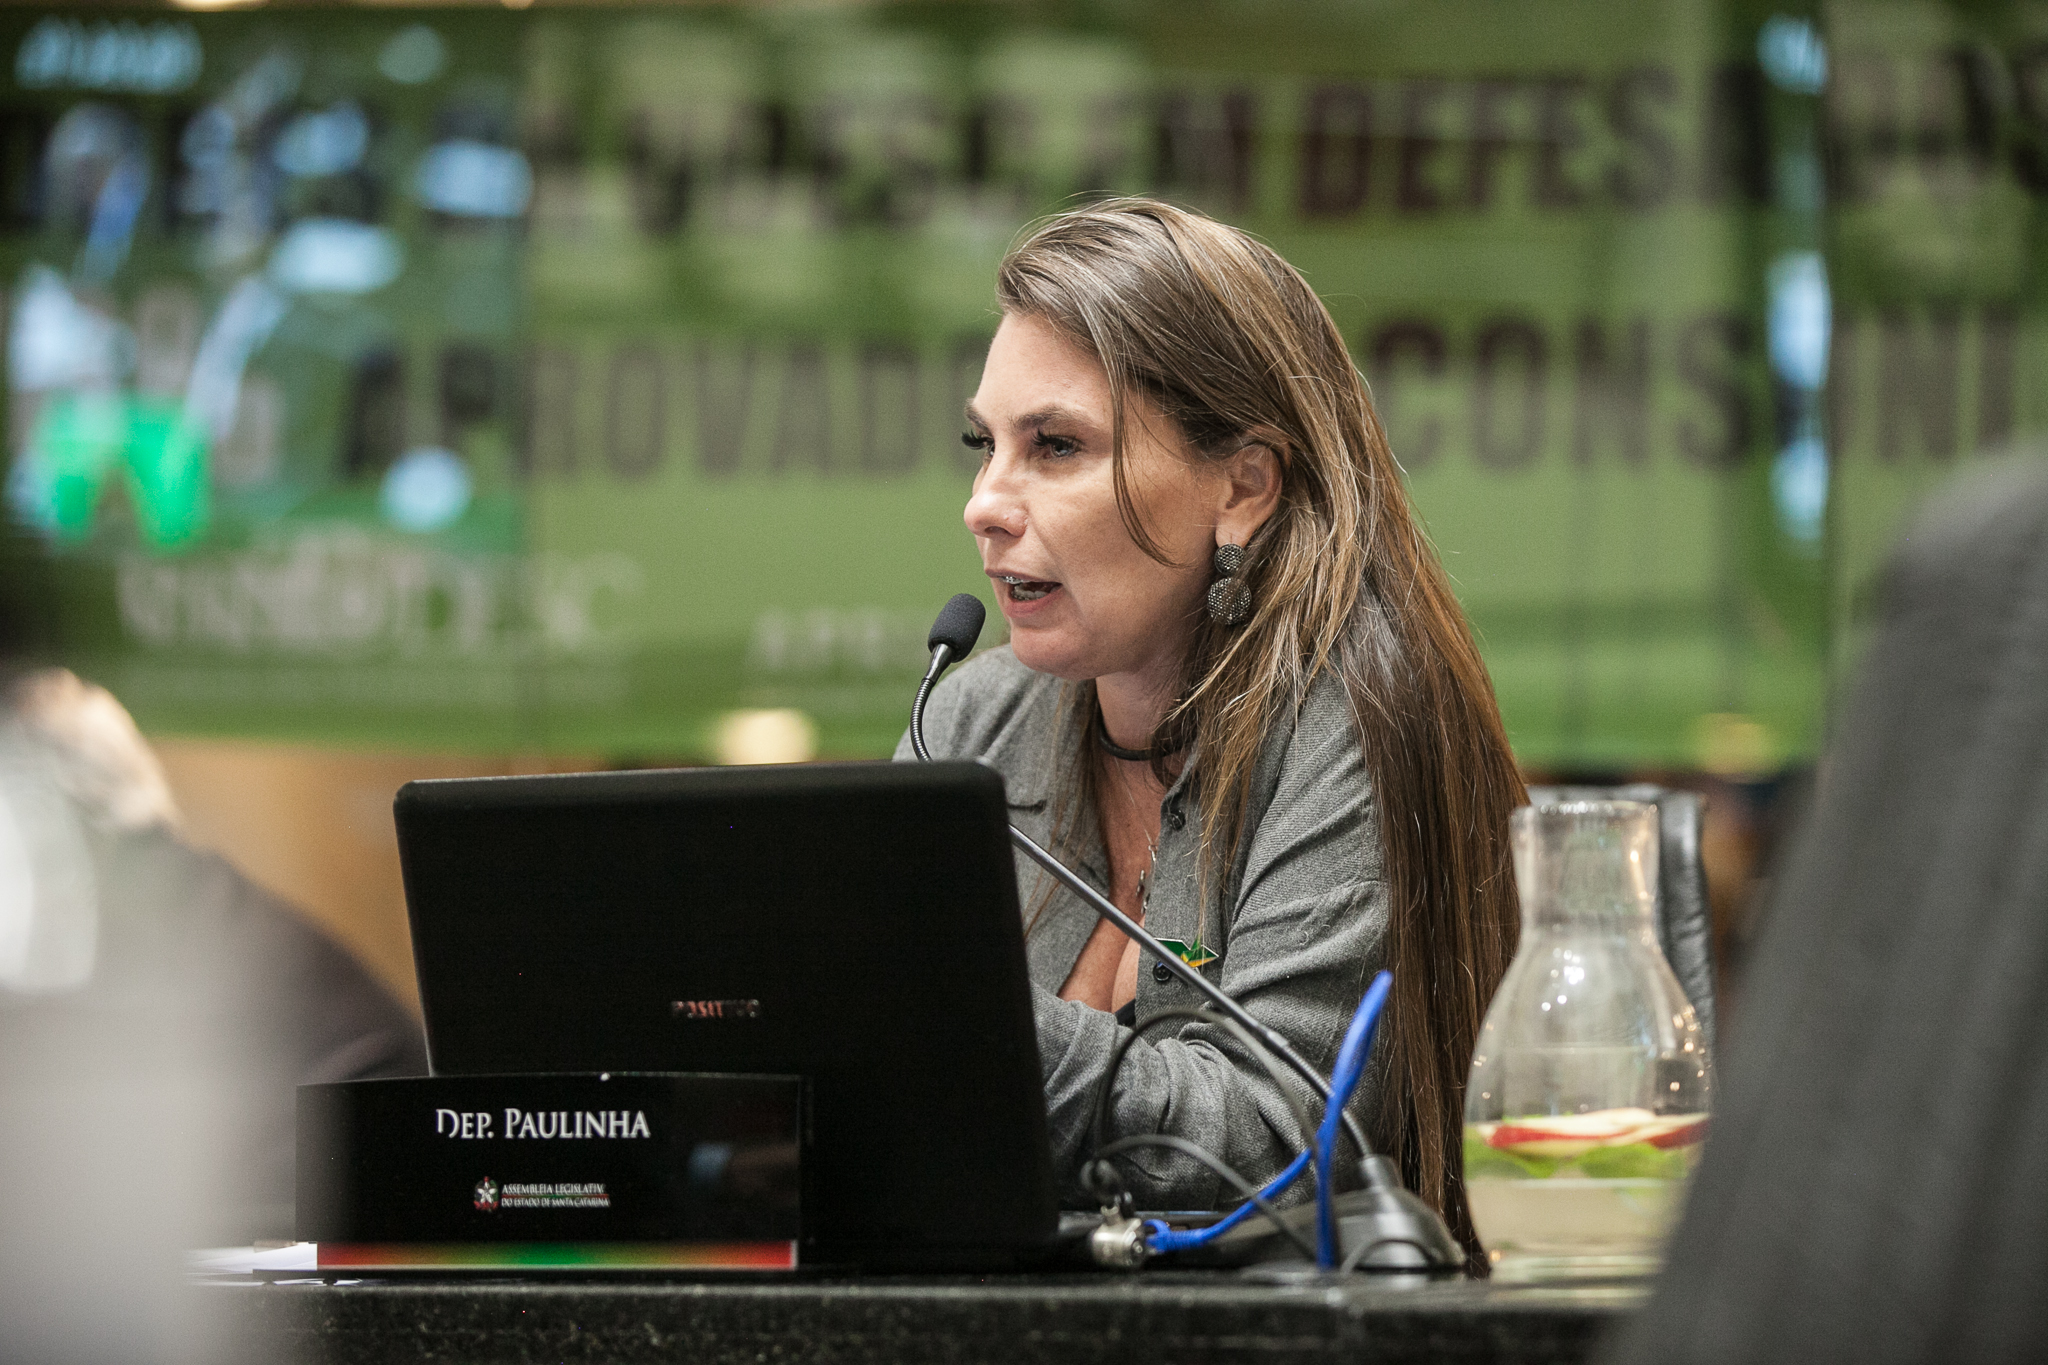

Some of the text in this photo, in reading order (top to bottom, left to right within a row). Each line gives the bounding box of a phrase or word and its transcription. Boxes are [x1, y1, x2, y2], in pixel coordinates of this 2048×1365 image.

[435, 1107, 652, 1139] DEP. PAULINHA
[501, 1183, 606, 1195] ASSEMBLEIA LEGISLATIV
[501, 1197, 610, 1207] DO ESTADO DE SANTA CATARINA
